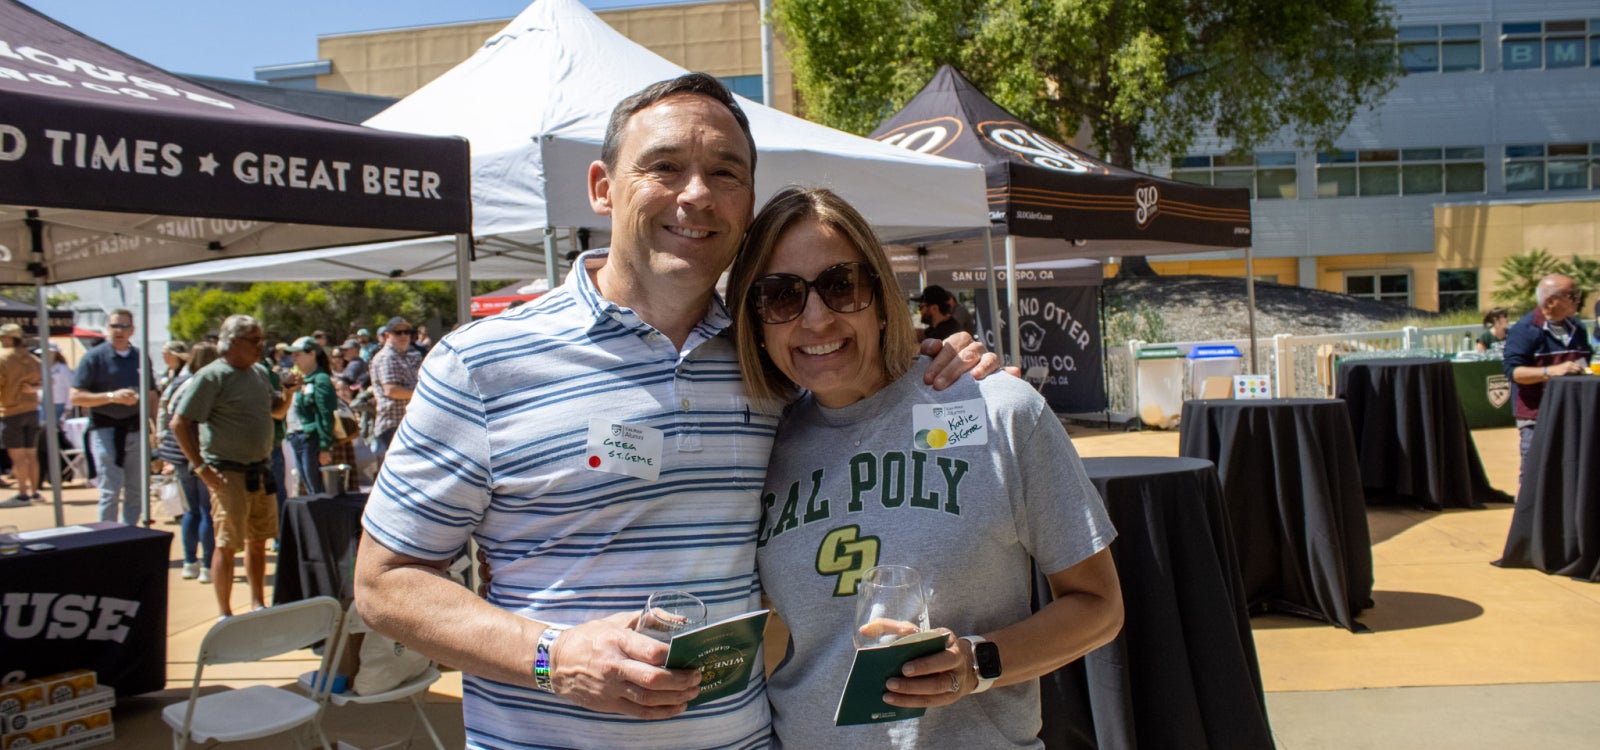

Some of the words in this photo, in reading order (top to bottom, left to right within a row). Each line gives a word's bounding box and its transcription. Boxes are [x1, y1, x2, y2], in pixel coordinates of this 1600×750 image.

[45, 129, 183, 177] TIMES
[232, 152, 350, 192] GREAT
[362, 164, 442, 200] BEER
[1136, 186, 1158, 224] SLO
[952, 271, 973, 282] SAN
[997, 270, 1036, 281] OSPO,
[1039, 270, 1054, 280] CA
[1018, 298, 1039, 317] ND
[1044, 302, 1090, 350] OTTER
[1052, 355, 1077, 371] CO.
[948, 414, 979, 431] Katie
[603, 438, 636, 451] GREG
[757, 468, 830, 548] CAL
[849, 450, 969, 516] POLY
[713, 656, 744, 669] WINE
